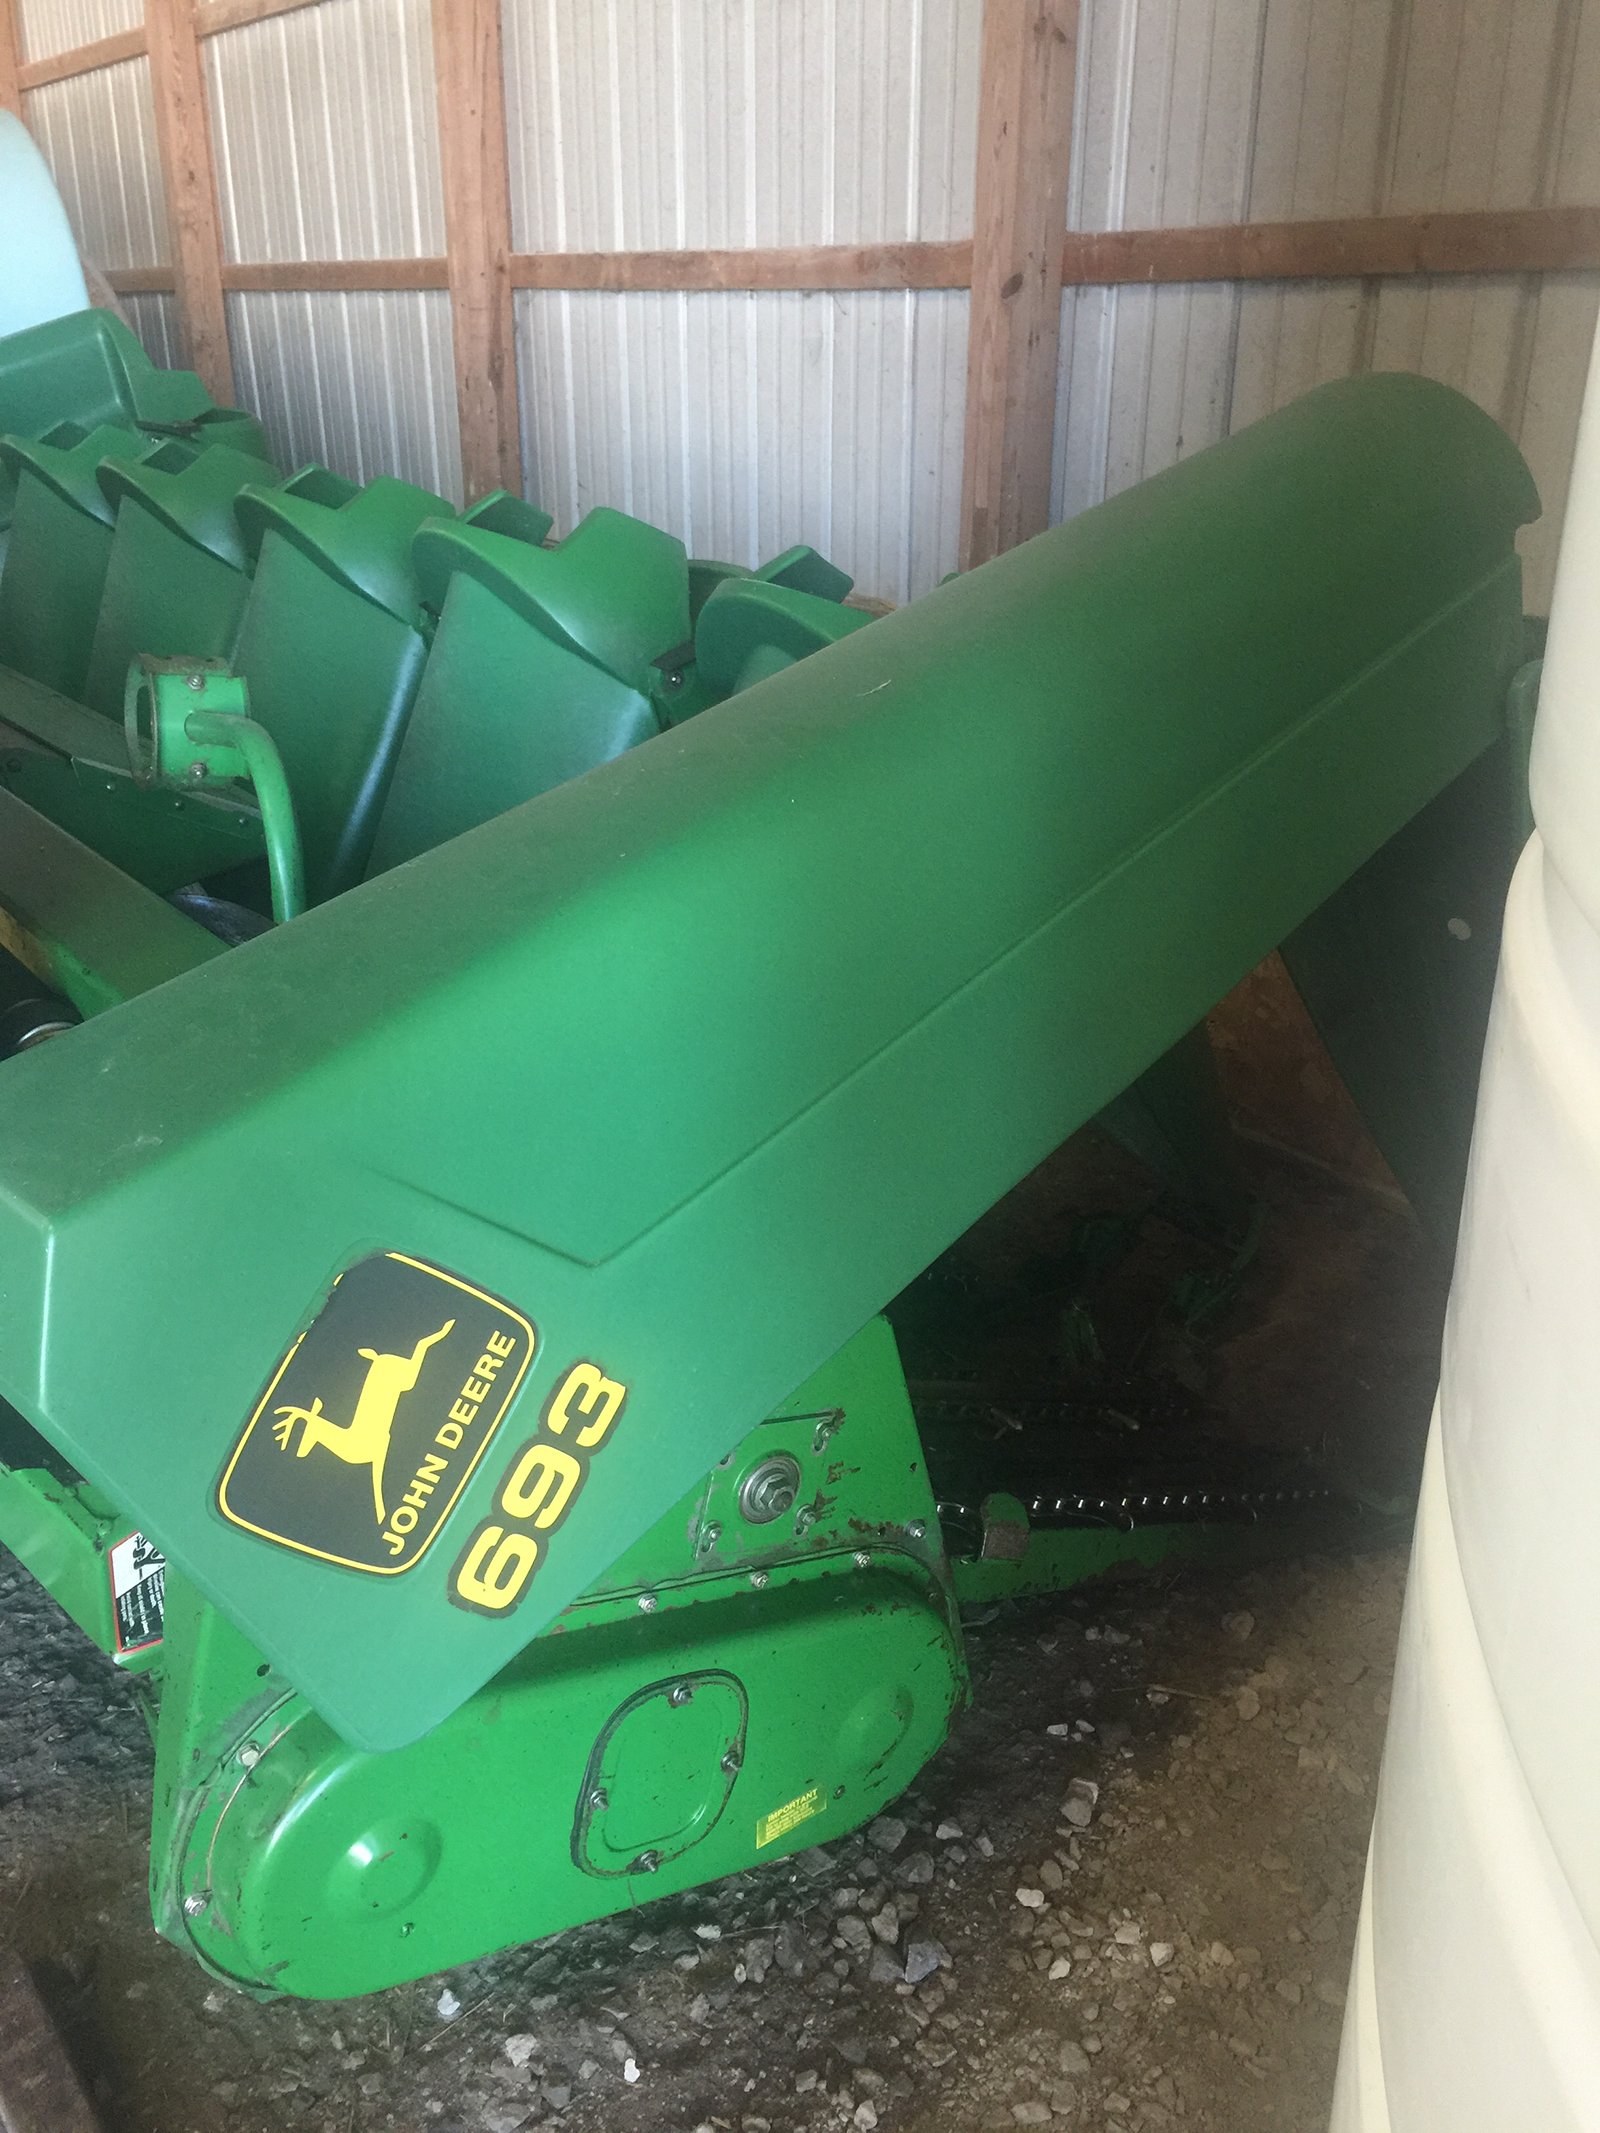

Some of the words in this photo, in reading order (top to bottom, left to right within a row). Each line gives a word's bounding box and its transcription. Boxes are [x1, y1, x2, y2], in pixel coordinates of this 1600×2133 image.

[382, 1453, 449, 1555] JOHN
[435, 1330, 516, 1449] DEERE
[456, 1363, 626, 1609] 693
[768, 1788, 818, 1822] IMPORTANT
